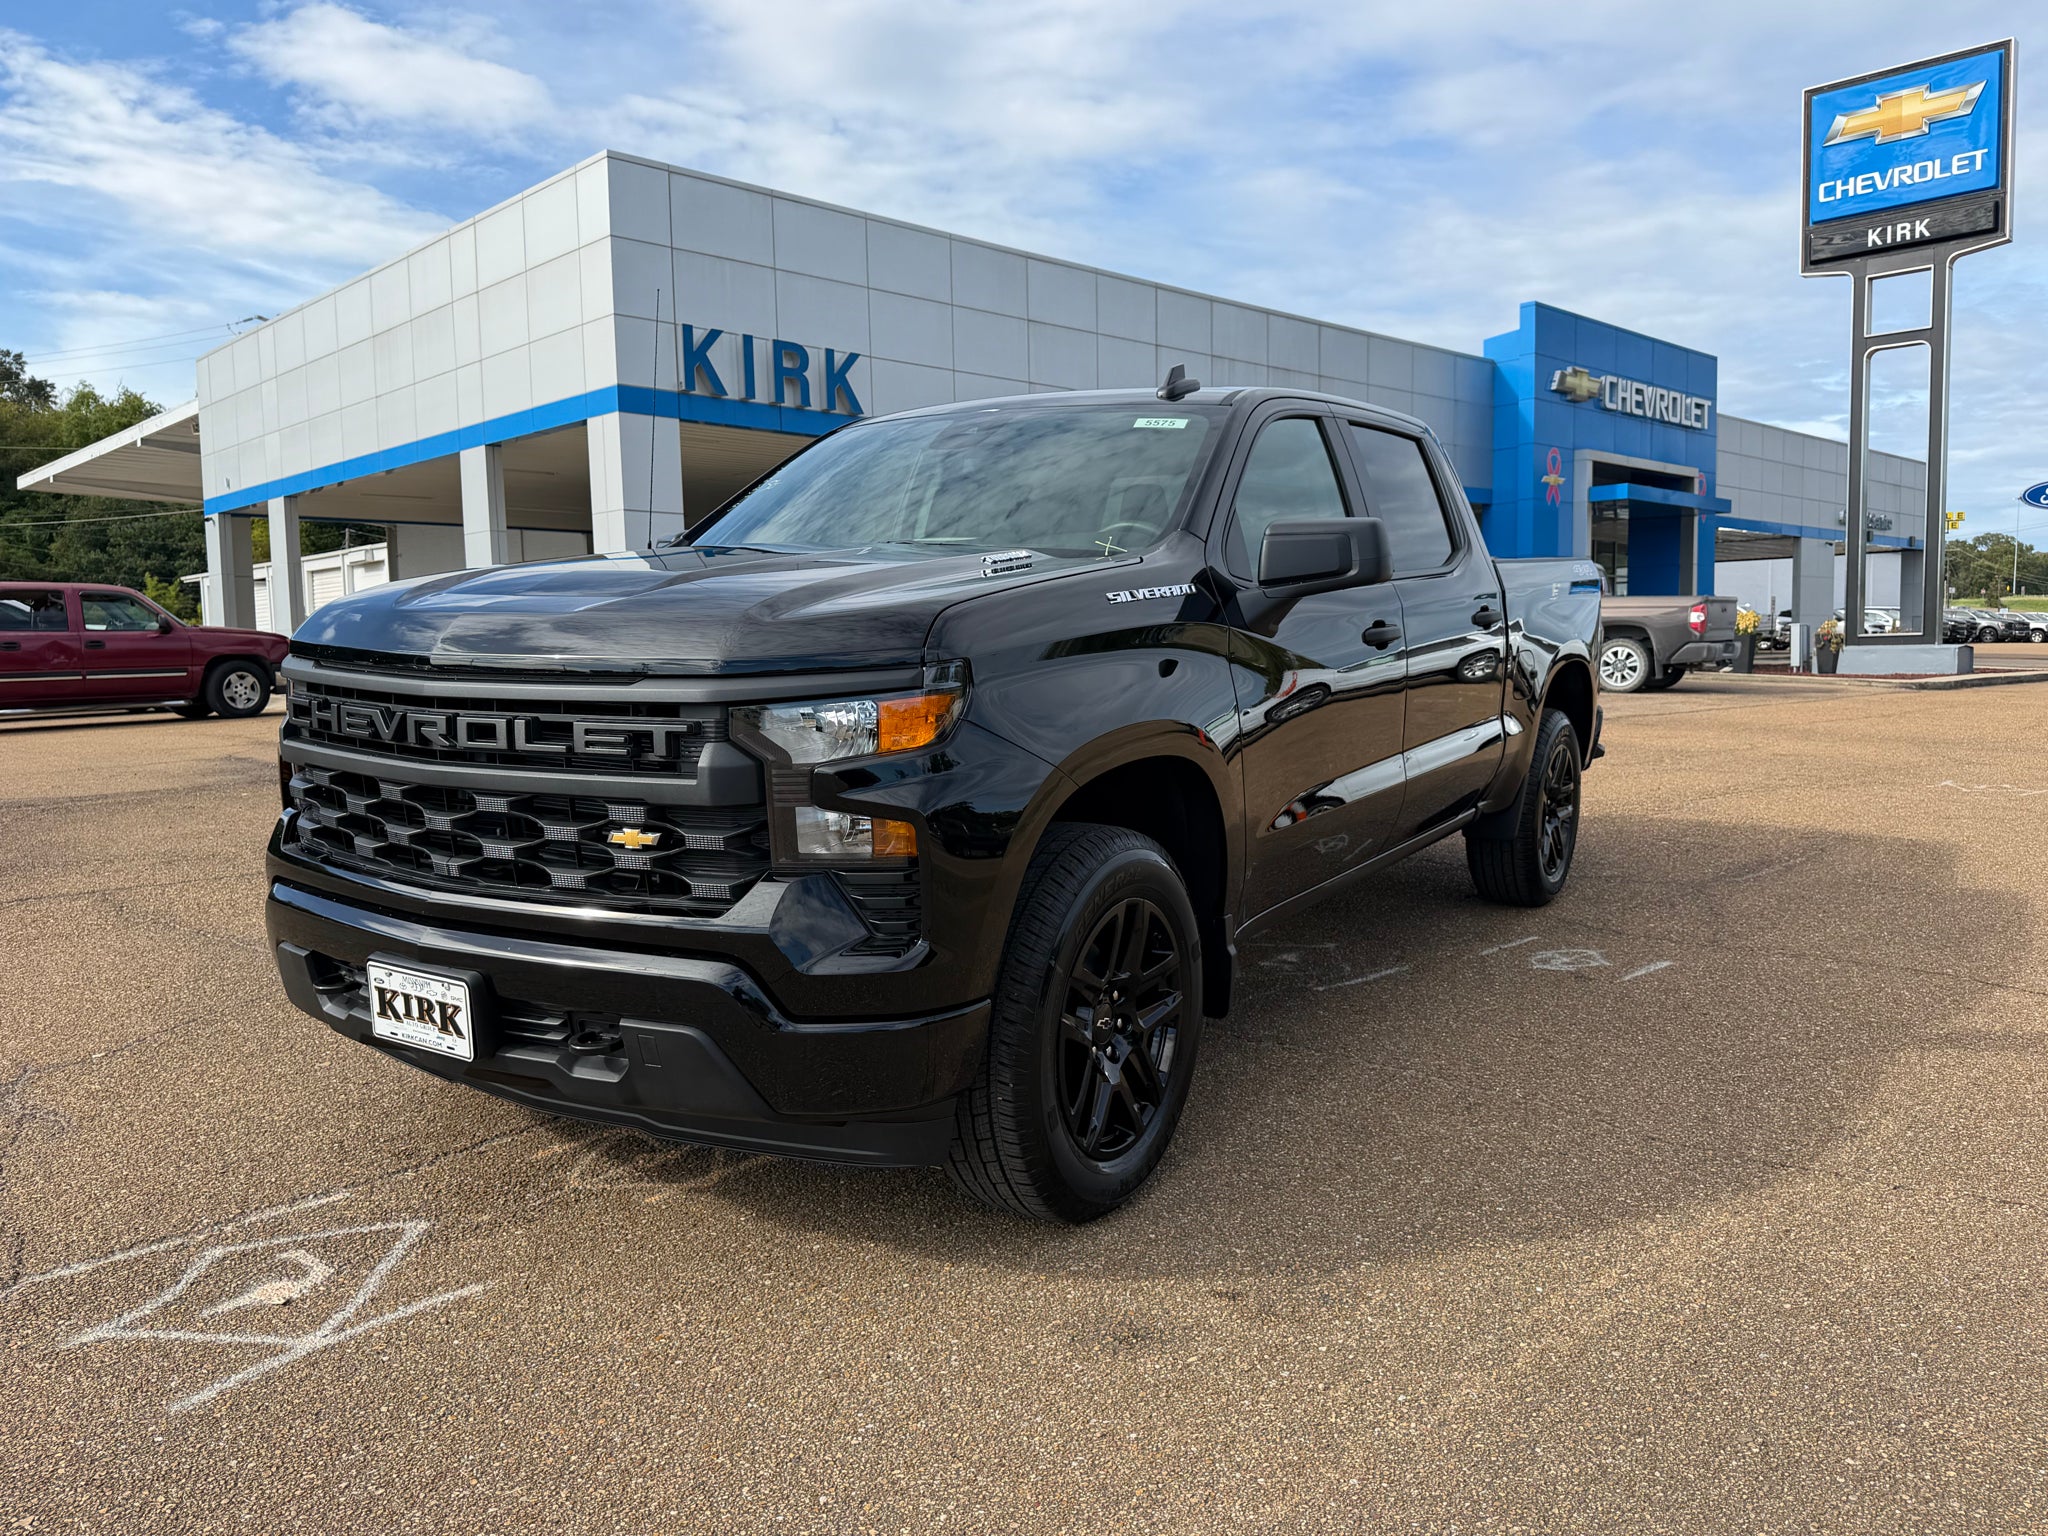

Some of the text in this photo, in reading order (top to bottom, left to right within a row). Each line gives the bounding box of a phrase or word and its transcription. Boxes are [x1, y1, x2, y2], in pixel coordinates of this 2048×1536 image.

[1818, 148, 1989, 203] CHEVROLET
[1867, 218, 1931, 247] KIRK
[681, 323, 865, 415] KIRK
[1144, 419, 1177, 427] 5575
[1601, 374, 1712, 430] CHEVROLET
[1105, 583, 1197, 605] SILVERADO
[287, 698, 701, 759] CHEVROLET
[374, 985, 467, 1040] KIRK
